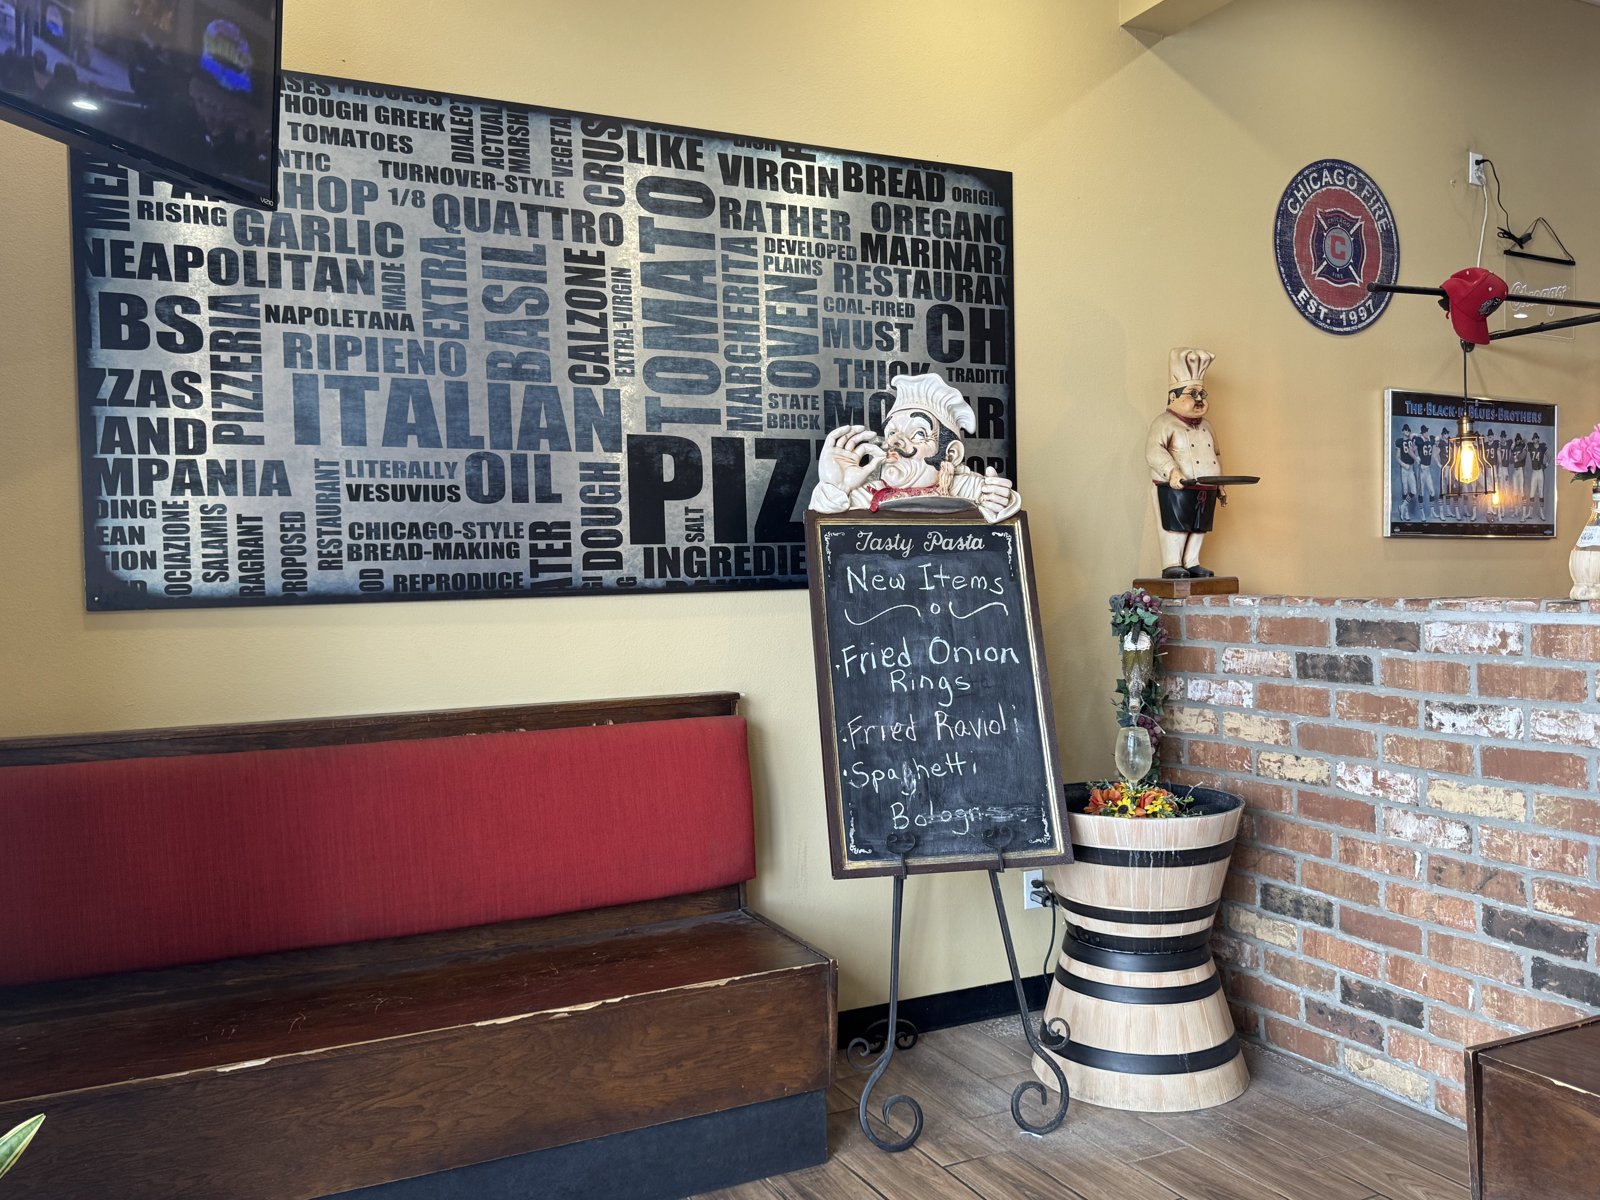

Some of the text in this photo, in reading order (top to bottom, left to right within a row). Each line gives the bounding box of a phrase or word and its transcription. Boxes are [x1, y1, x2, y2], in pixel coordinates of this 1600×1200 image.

[280, 93, 446, 132] HOUGH GREEK
[449, 101, 474, 164] DIALEC
[287, 121, 413, 154] TOMATOES
[626, 130, 704, 172] LIKE
[378, 159, 564, 199] TURNOVER-STYLE
[581, 118, 625, 207] CRUS
[717, 152, 839, 199] VIRGIN
[842, 161, 946, 203] BREAD
[137, 200, 228, 227] RISING
[278, 171, 379, 215] HOP
[388, 188, 426, 209] 1/8
[1287, 169, 1391, 234] CHICAGO FIRE
[233, 208, 404, 259] GARLIC
[432, 193, 624, 247] QUATTRO
[719, 196, 851, 242] RATHER
[88, 237, 376, 295] NEAPOLITAN
[764, 237, 858, 261] DEVELOPED
[764, 255, 823, 276] PLAINS
[1330, 235, 1346, 261] C
[380, 261, 406, 311] MADE
[419, 237, 470, 340] EXTRA
[636, 175, 722, 433] TOMATO
[823, 296, 916, 319] COAL-FIRED
[1297, 288, 1376, 327] EST. 1997
[98, 291, 204, 354] BS
[264, 303, 416, 333] NAPOLETANA
[481, 243, 552, 384] BASIL
[564, 247, 611, 386] CALZONE
[611, 266, 636, 378] EXTRA-VIRGIN
[720, 235, 763, 432] MARGHERITA
[765, 274, 822, 388] OVEN
[822, 317, 914, 353] MUST
[207, 293, 265, 446] PIZZERIA
[282, 331, 467, 378] RIPIENO
[292, 372, 623, 453] ITALIAN
[766, 412, 821, 430] BRICK
[768, 393, 820, 411] STATE
[1405, 400, 1424, 415] THE
[1426, 404, 1456, 418] BLACK
[1469, 405, 1495, 420] BLUES
[1498, 408, 1542, 424] BROTHERS
[345, 460, 458, 480] LITERALLY
[464, 451, 563, 504] OIL
[1531, 451, 1540, 461] 74
[314, 458, 343, 571] RESTAURANT
[346, 484, 461, 502] VESUVIUS
[348, 521, 525, 541] CHICAGO-STYLE
[579, 462, 624, 571] DOUGH
[684, 506, 705, 543] SALT
[200, 503, 230, 583] SALAMIS
[346, 541, 521, 562] BREAD-MAKING
[856, 530, 986, 558] Tasty Pasta
[392, 571, 525, 593] REPRODUCE
[846, 562, 1005, 595] New Items
[841, 636, 1020, 679] Fried Onion
[890, 669, 971, 707] Rings
[847, 702, 1020, 750] Fried Ravioli
[848, 751, 978, 796] Spaghetti
